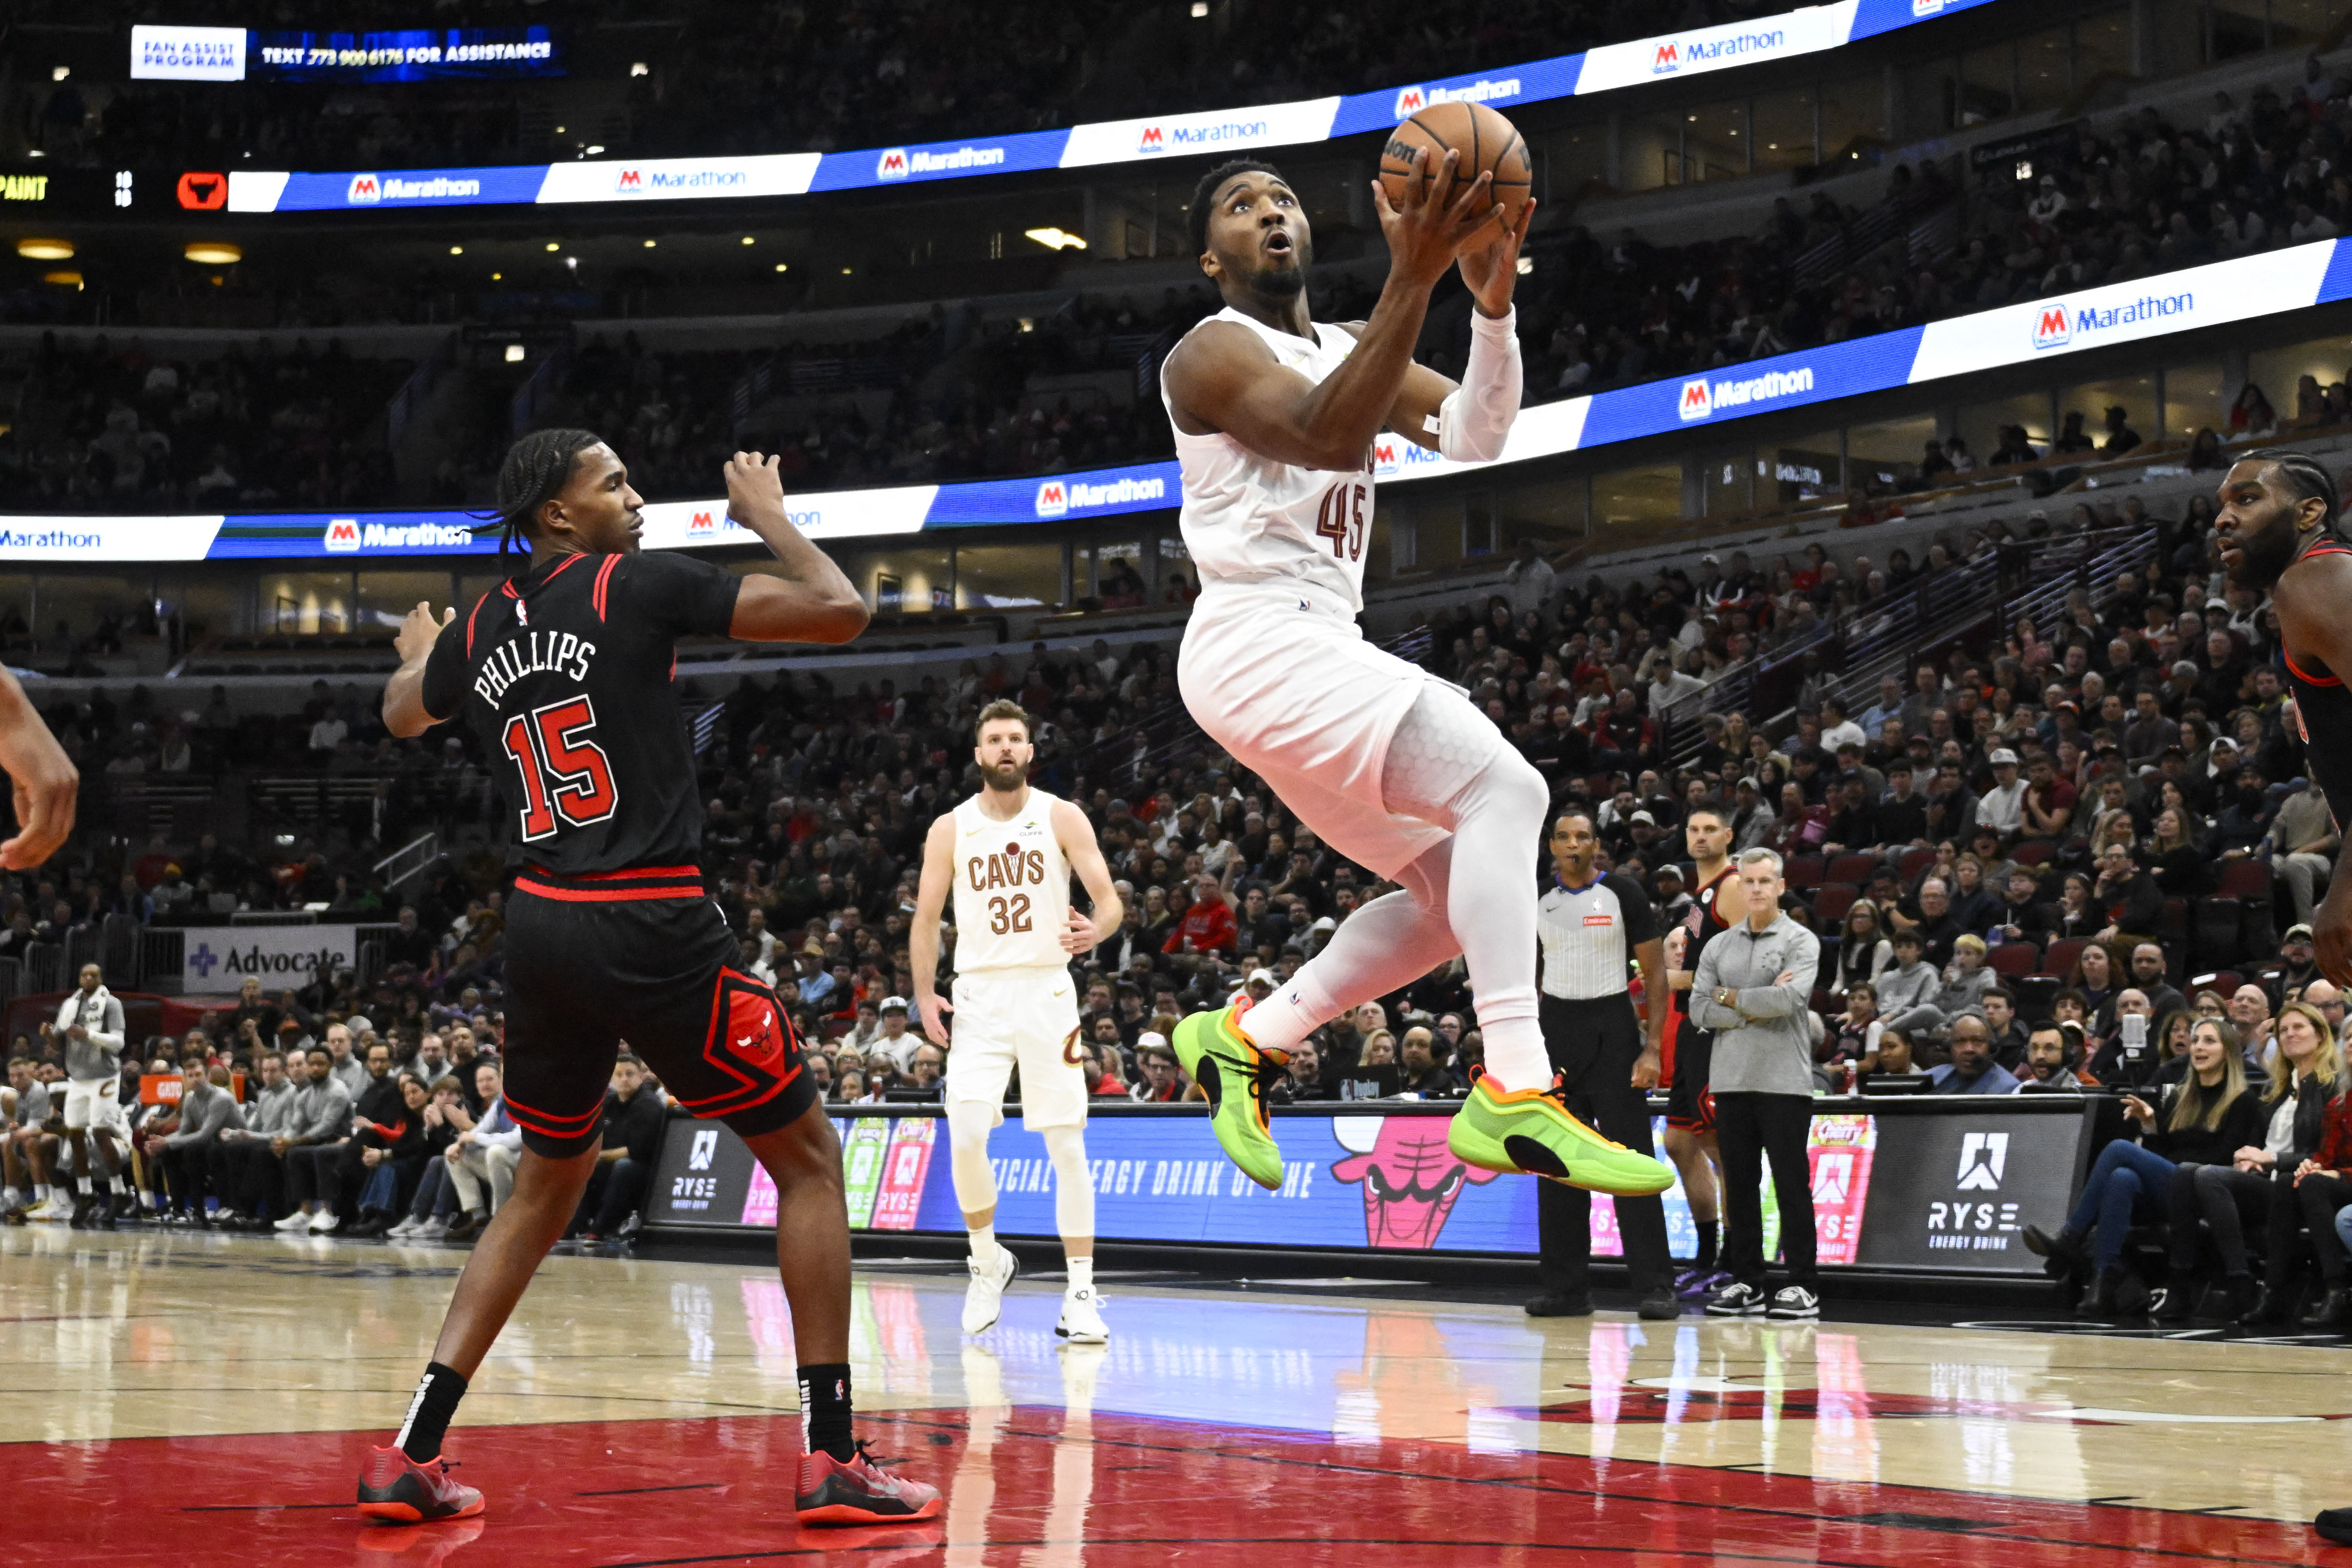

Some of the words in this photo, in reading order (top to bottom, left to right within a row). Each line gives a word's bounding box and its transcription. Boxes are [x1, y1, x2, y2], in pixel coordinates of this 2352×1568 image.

[145, 42, 175, 52] FAN
[183, 43, 234, 53] ASSIST
[263, 48, 304, 64] TEXT
[406, 47, 441, 63] FOR
[445, 42, 551, 62] ASSISTANCE
[1687, 29, 1784, 62] Marathon
[145, 55, 234, 66] PROGRAM
[1429, 79, 1520, 104] Marathon
[1173, 119, 1267, 146] Marathon
[911, 147, 1004, 172] Marathon
[383, 178, 479, 198] Marathon
[651, 171, 746, 188] Marathon
[2076, 290, 2194, 333] Marathon
[1714, 367, 1813, 409] Marathon
[1071, 478, 1164, 507] Marathon
[1316, 481, 1366, 562] 45
[0, 530, 100, 547] Marathon
[364, 524, 471, 547] Marathon
[474, 631, 596, 710] PHILLIPS
[502, 694, 618, 842] 15
[969, 849, 1044, 892] CAVS
[988, 893, 1032, 935] 32
[225, 945, 345, 973] Advocate
[672, 1177, 716, 1198] RYSE
[991, 1158, 1052, 1192] FICIAL
[1091, 1159, 1147, 1194] ERGY
[1152, 1160, 1224, 1195] DRINK
[1271, 1162, 1315, 1199] HE
[750, 1189, 777, 1207] RYS
[846, 1192, 872, 1210] YSE
[880, 1192, 919, 1211] RYSE
[1928, 1202, 2019, 1230] RYSE
[1929, 1235, 1970, 1249] ENERGY
[1973, 1236, 2008, 1251] DRINK
